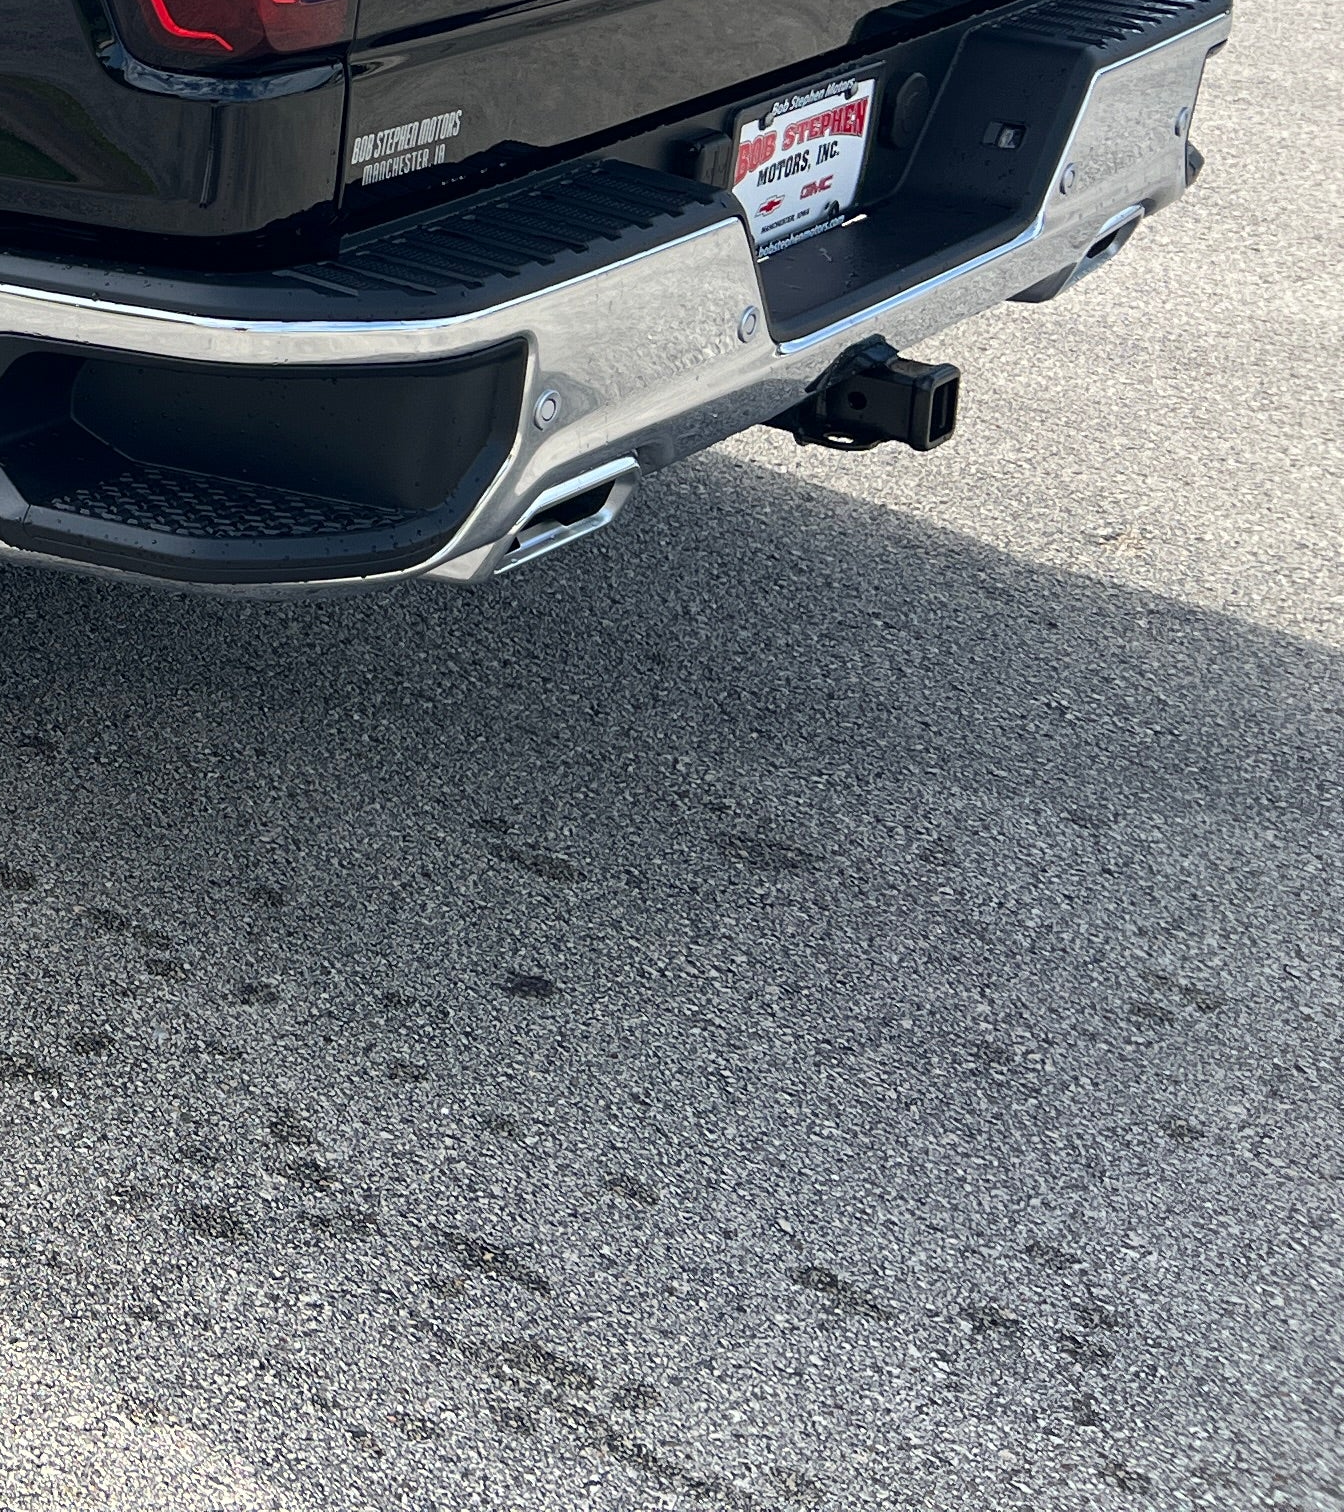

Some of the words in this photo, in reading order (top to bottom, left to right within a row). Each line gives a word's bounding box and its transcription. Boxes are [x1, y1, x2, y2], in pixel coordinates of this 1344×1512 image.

[771, 100, 789, 116] Bob
[790, 88, 825, 111] Stephen
[351, 133, 375, 164] BOB
[374, 121, 419, 159] STEPHEN
[418, 109, 463, 146] MOTORS
[433, 144, 446, 165] IA
[734, 129, 778, 185] BOB
[782, 96, 870, 152] STEPHEN
[756, 149, 811, 187] MOTORS,
[815, 140, 840, 166] INC.
[799, 174, 835, 201] GMC
